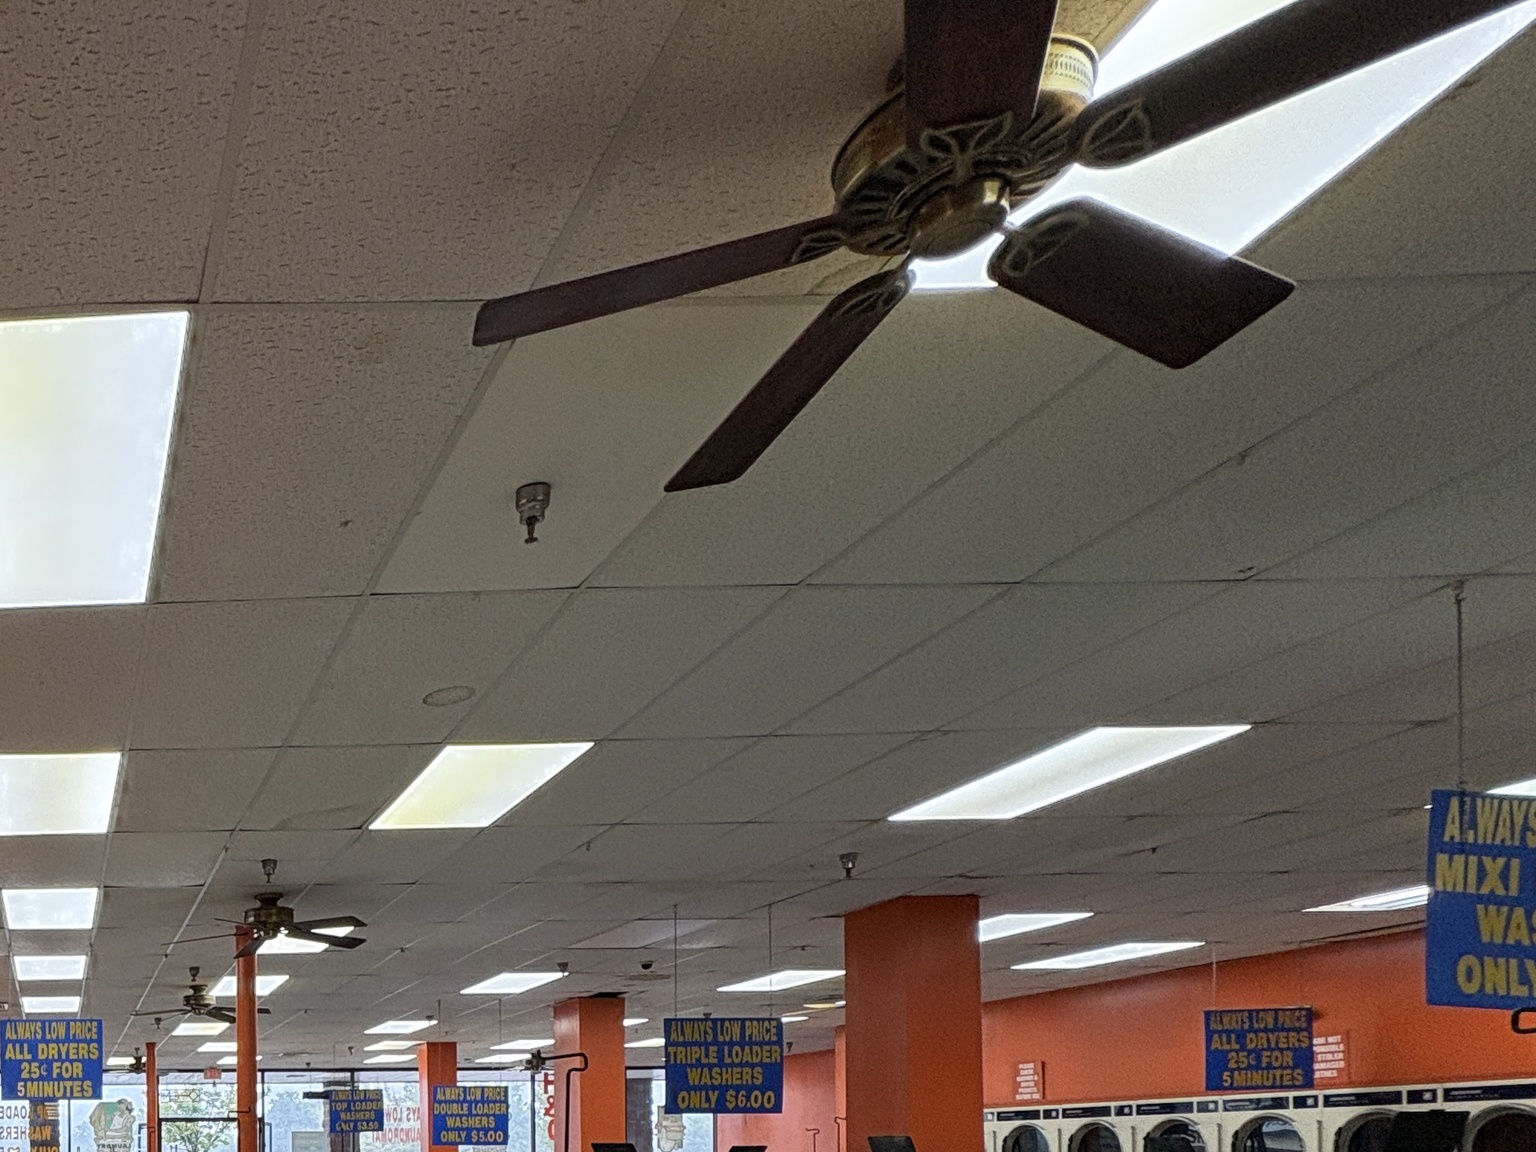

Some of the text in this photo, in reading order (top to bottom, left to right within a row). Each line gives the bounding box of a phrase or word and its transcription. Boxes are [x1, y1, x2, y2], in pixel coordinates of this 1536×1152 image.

[1443, 796, 1536, 849] ALWAYS
[1434, 852, 1521, 896] MIXI
[1476, 903, 1536, 946] WA
[1210, 1009, 1307, 1030] ALWAYS LOW PRICE
[5, 1020, 98, 1040] ALWAYS LOW PRICE
[670, 1020, 777, 1042] ALWAYS LOW PRICE
[1210, 1031, 1309, 1050] ALL DRYERS
[5, 1043, 99, 1060] ALL DRYERS
[668, 1045, 781, 1064] TRIPLE LOADER
[1261, 1050, 1294, 1067] FOR
[52, 1062, 83, 1078] FOR
[687, 1066, 763, 1086] WASHERS
[436, 1087, 505, 1101] ALWAYS LOW PRICE
[677, 1089, 775, 1110] ONLY $6.00
[331, 1101, 384, 1111] TOP LOADER
[340, 1111, 375, 1120] WASHERS
[434, 1102, 507, 1115] DOUBLE LOADER
[446, 1116, 495, 1128] WASHERS
[440, 1130, 504, 1143] ONLY $5.00
